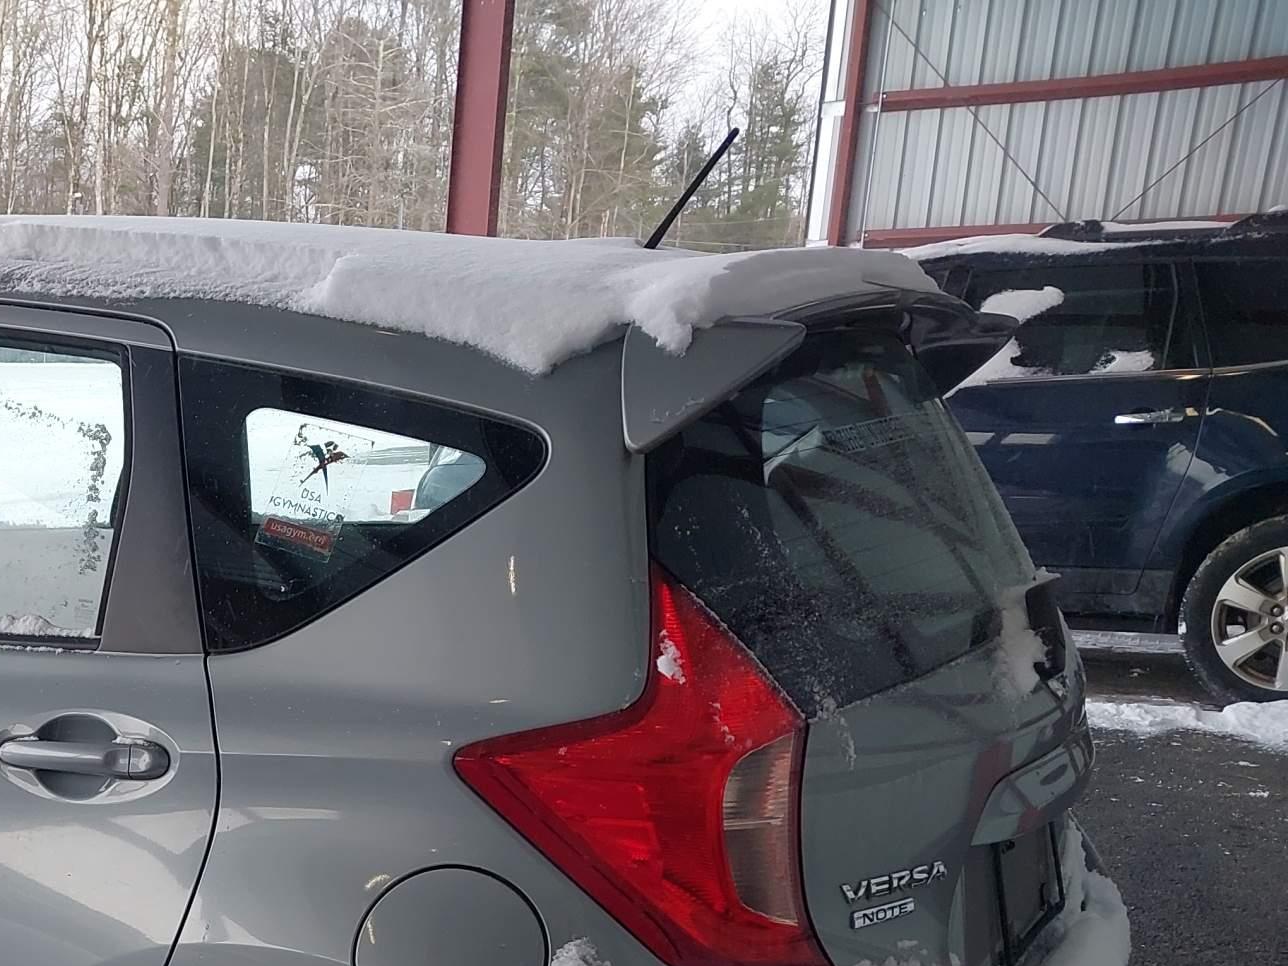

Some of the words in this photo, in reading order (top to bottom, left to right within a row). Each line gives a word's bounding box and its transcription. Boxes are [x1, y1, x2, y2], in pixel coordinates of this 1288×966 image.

[301, 487, 322, 504] USA
[840, 860, 948, 904] VERSA
[861, 903, 910, 924] NOTE
